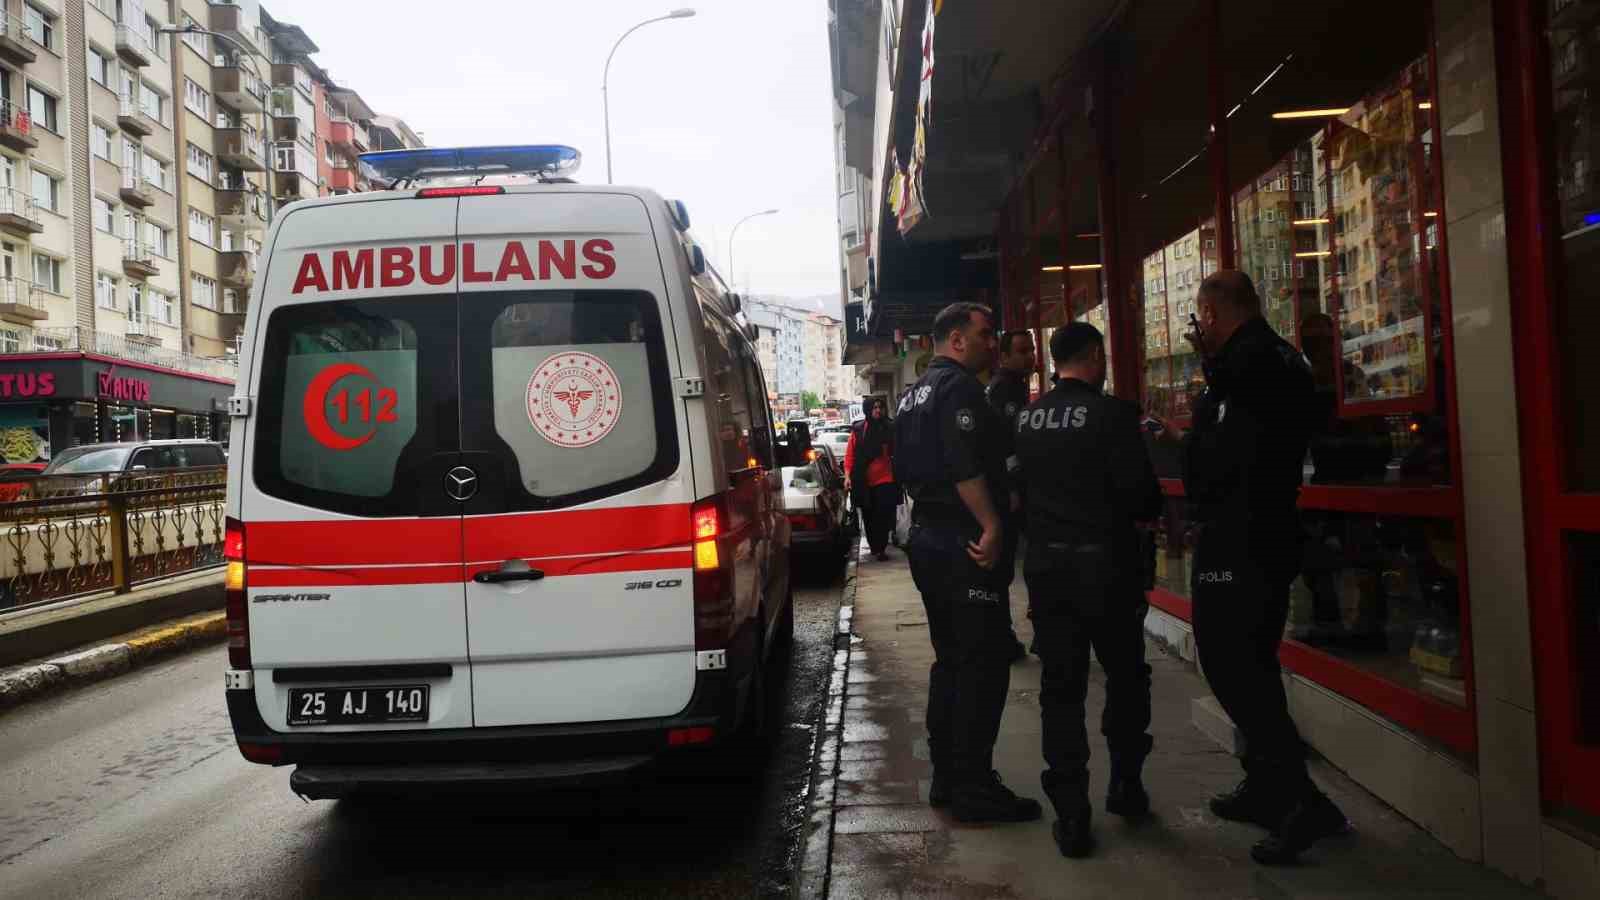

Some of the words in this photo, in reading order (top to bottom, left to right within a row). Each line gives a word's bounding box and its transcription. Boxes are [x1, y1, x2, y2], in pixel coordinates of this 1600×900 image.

[292, 238, 617, 294] AMBULANS
[113, 376, 151, 401] ALTUS
[331, 387, 400, 424] 112
[252, 593, 332, 603] SPRINTER
[301, 692, 326, 716] 25
[342, 691, 367, 714] AJ
[385, 689, 422, 713] 140
